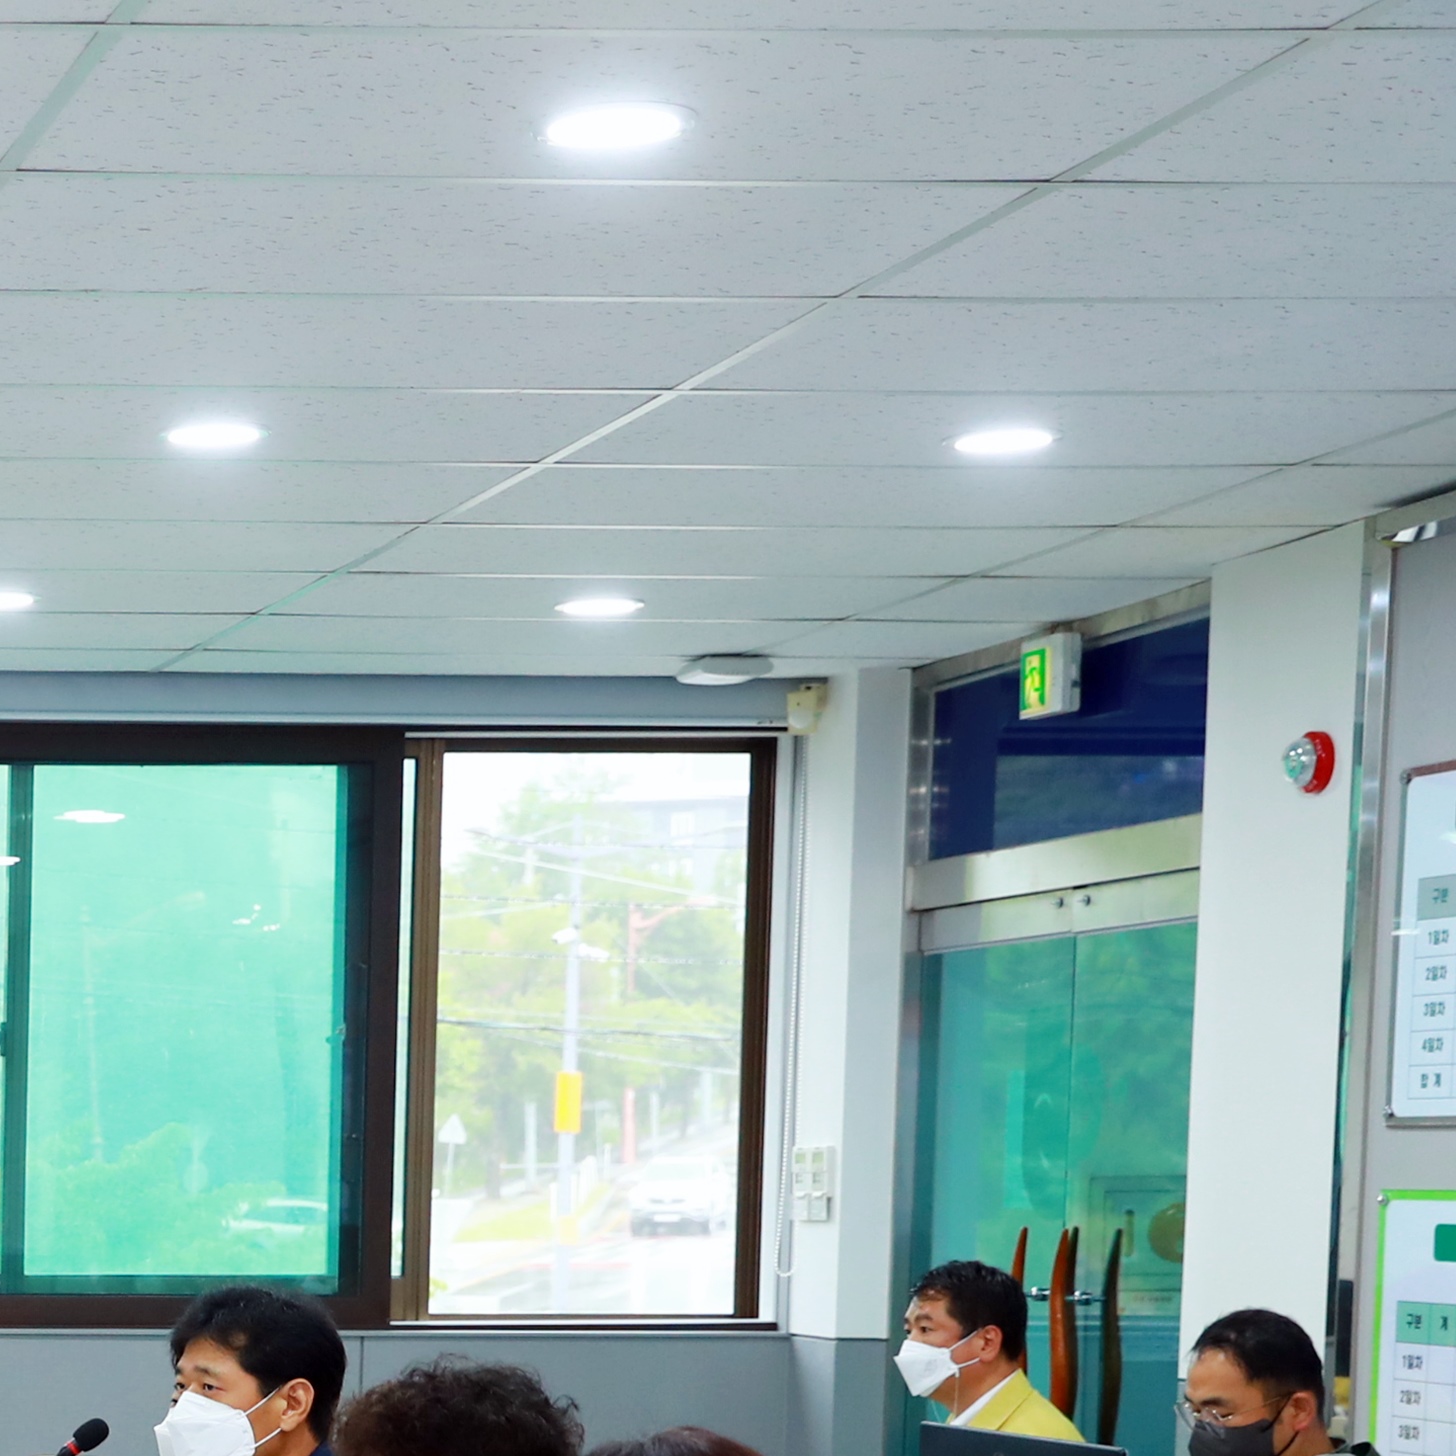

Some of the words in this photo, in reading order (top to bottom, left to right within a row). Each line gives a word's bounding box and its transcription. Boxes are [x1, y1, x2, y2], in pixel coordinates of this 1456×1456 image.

[1432, 887, 1449, 903] 구분
[1427, 929, 1450, 946] 1일차
[1425, 966, 1448, 982] 2일차
[1422, 1001, 1446, 1017] 3일차
[1421, 1037, 1444, 1053] 4일차
[1405, 1313, 1422, 1329] 구분
[1440, 1315, 1449, 1331] 계
[1402, 1354, 1423, 1370] 1일차
[1399, 1389, 1422, 1406] 2일차
[1397, 1424, 1421, 1440] 3일차
